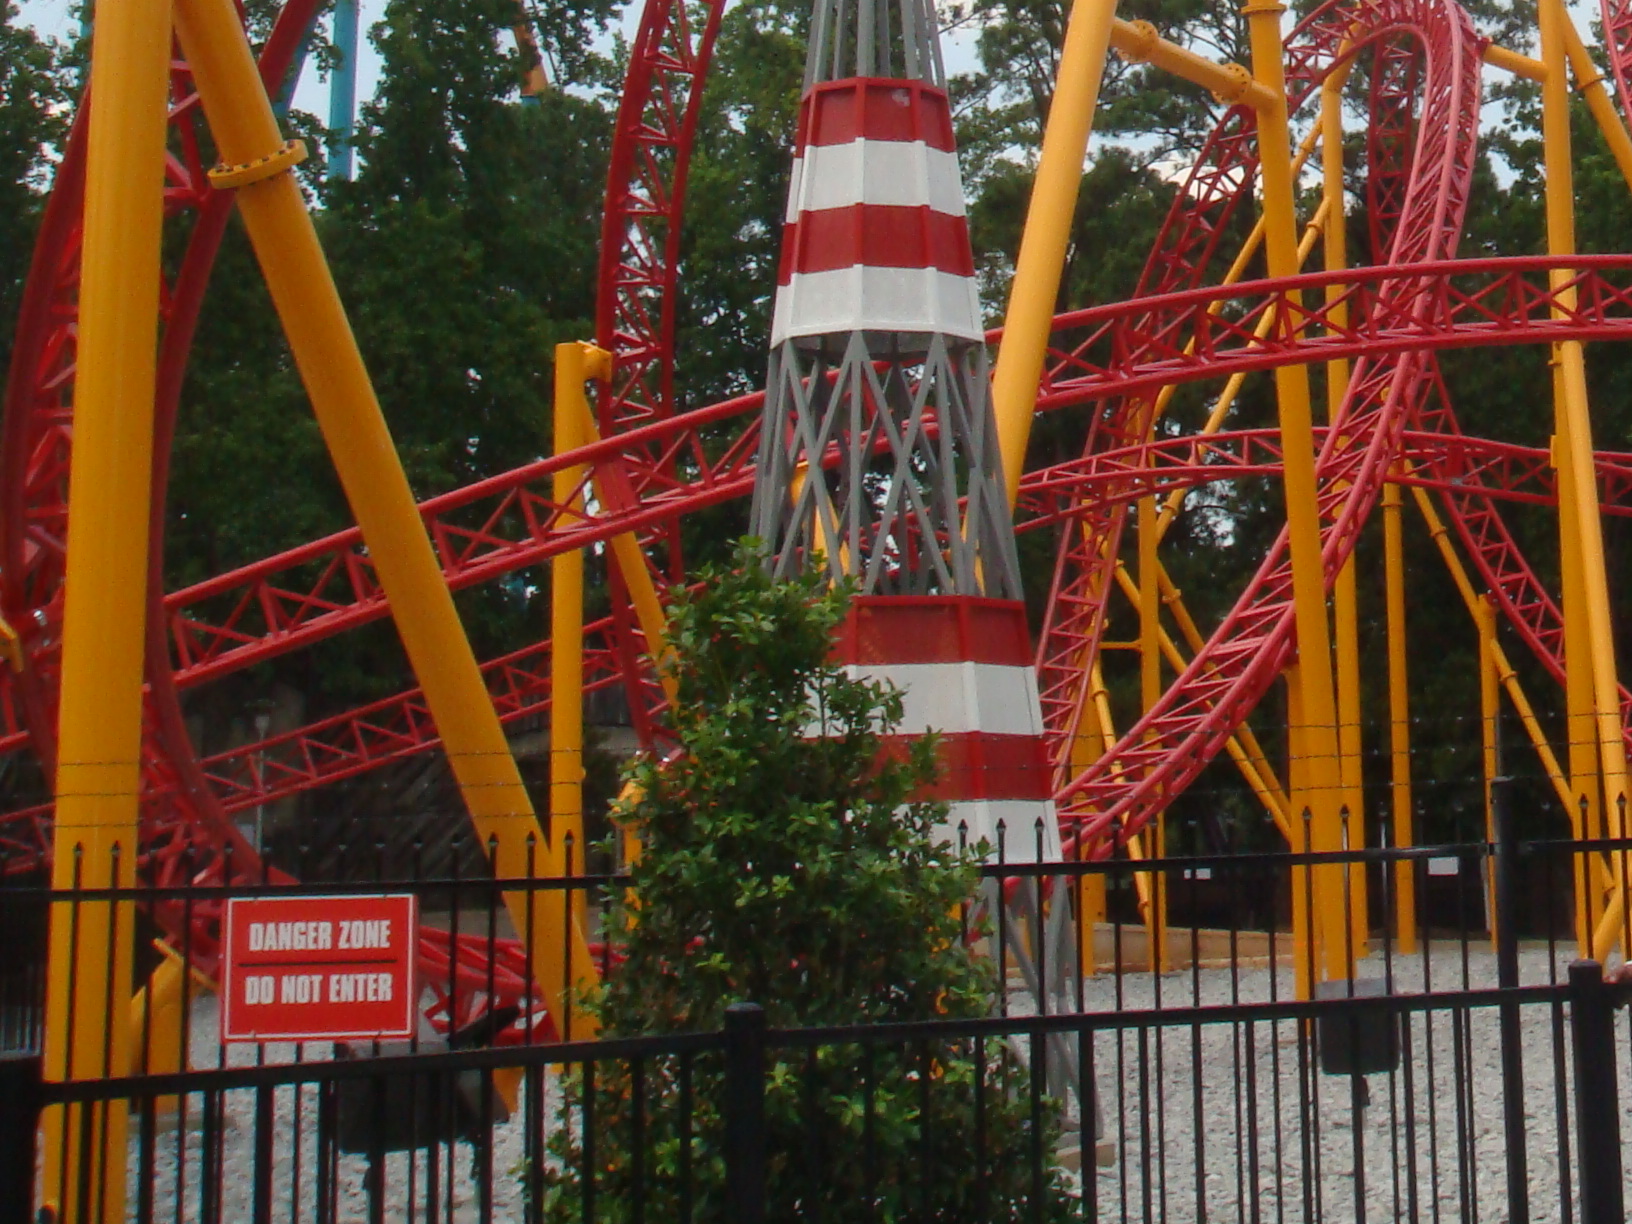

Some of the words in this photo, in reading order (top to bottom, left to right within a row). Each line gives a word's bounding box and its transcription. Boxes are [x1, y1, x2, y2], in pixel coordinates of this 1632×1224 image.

[249, 921, 332, 951] DANGER
[338, 920, 391, 949] ZONE
[245, 976, 275, 1005] DO
[281, 975, 323, 1004] NOT
[329, 973, 393, 1003] ENTER
